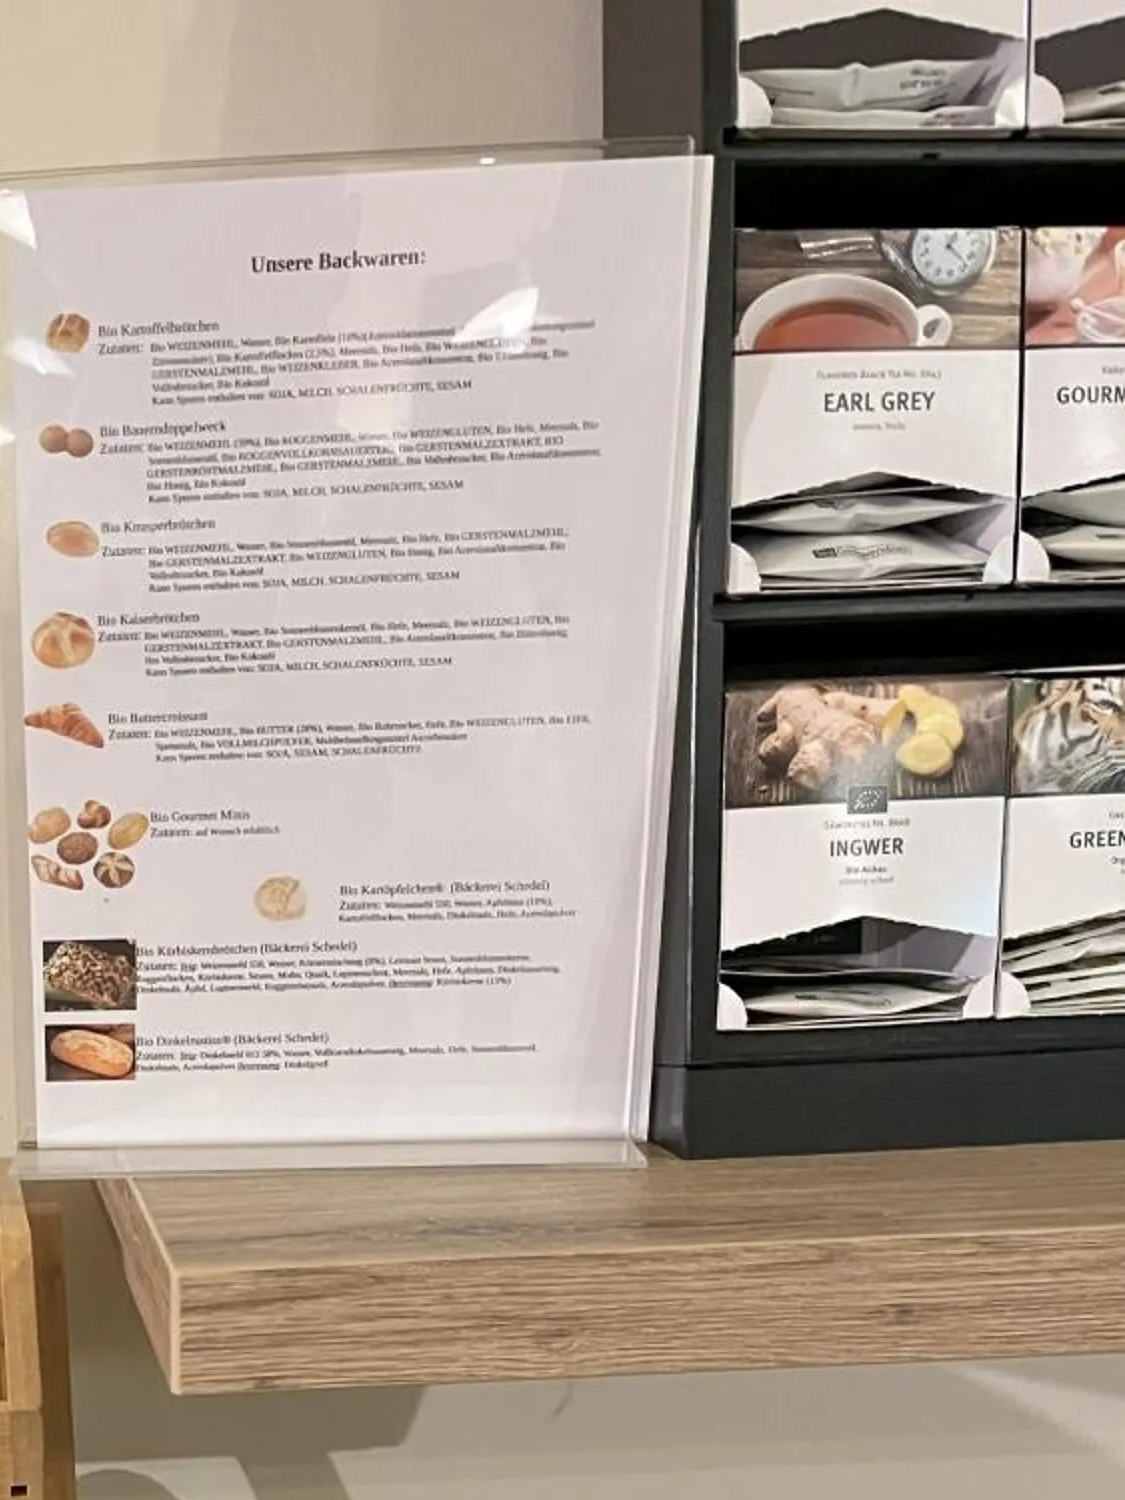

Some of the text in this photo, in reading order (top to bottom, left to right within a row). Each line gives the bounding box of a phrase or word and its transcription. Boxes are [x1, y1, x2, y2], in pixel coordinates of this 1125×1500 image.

[251, 250, 426, 274] Unsere Backwaren:
[97, 318, 219, 338] Bio Kartoffelbrötchen
[97, 341, 143, 355] Zutaten:
[824, 391, 935, 412] EARL GREY
[100, 425, 119, 437] Bio
[427, 478, 463, 490] SESAM
[101, 521, 120, 533] Bio
[97, 611, 199, 626] Bio Kaiserbrötchen
[107, 713, 126, 724] Bio
[150, 808, 251, 822] Bio Gourmet Minis
[151, 826, 193, 838] Zutaten:
[830, 837, 904, 857] INGWER
[339, 884, 358, 896] Bio
[450, 880, 501, 894] (Bäckerei
[339, 901, 381, 911] Zutaten:
[135, 945, 154, 957] Bio
[259, 940, 309, 955] (Bäckerei
[312, 939, 357, 953] Schedel)
[136, 1037, 153, 1047] Bio
[233, 1033, 281, 1045] (Bäckerei
[283, 1031, 329, 1044] Schedel)
